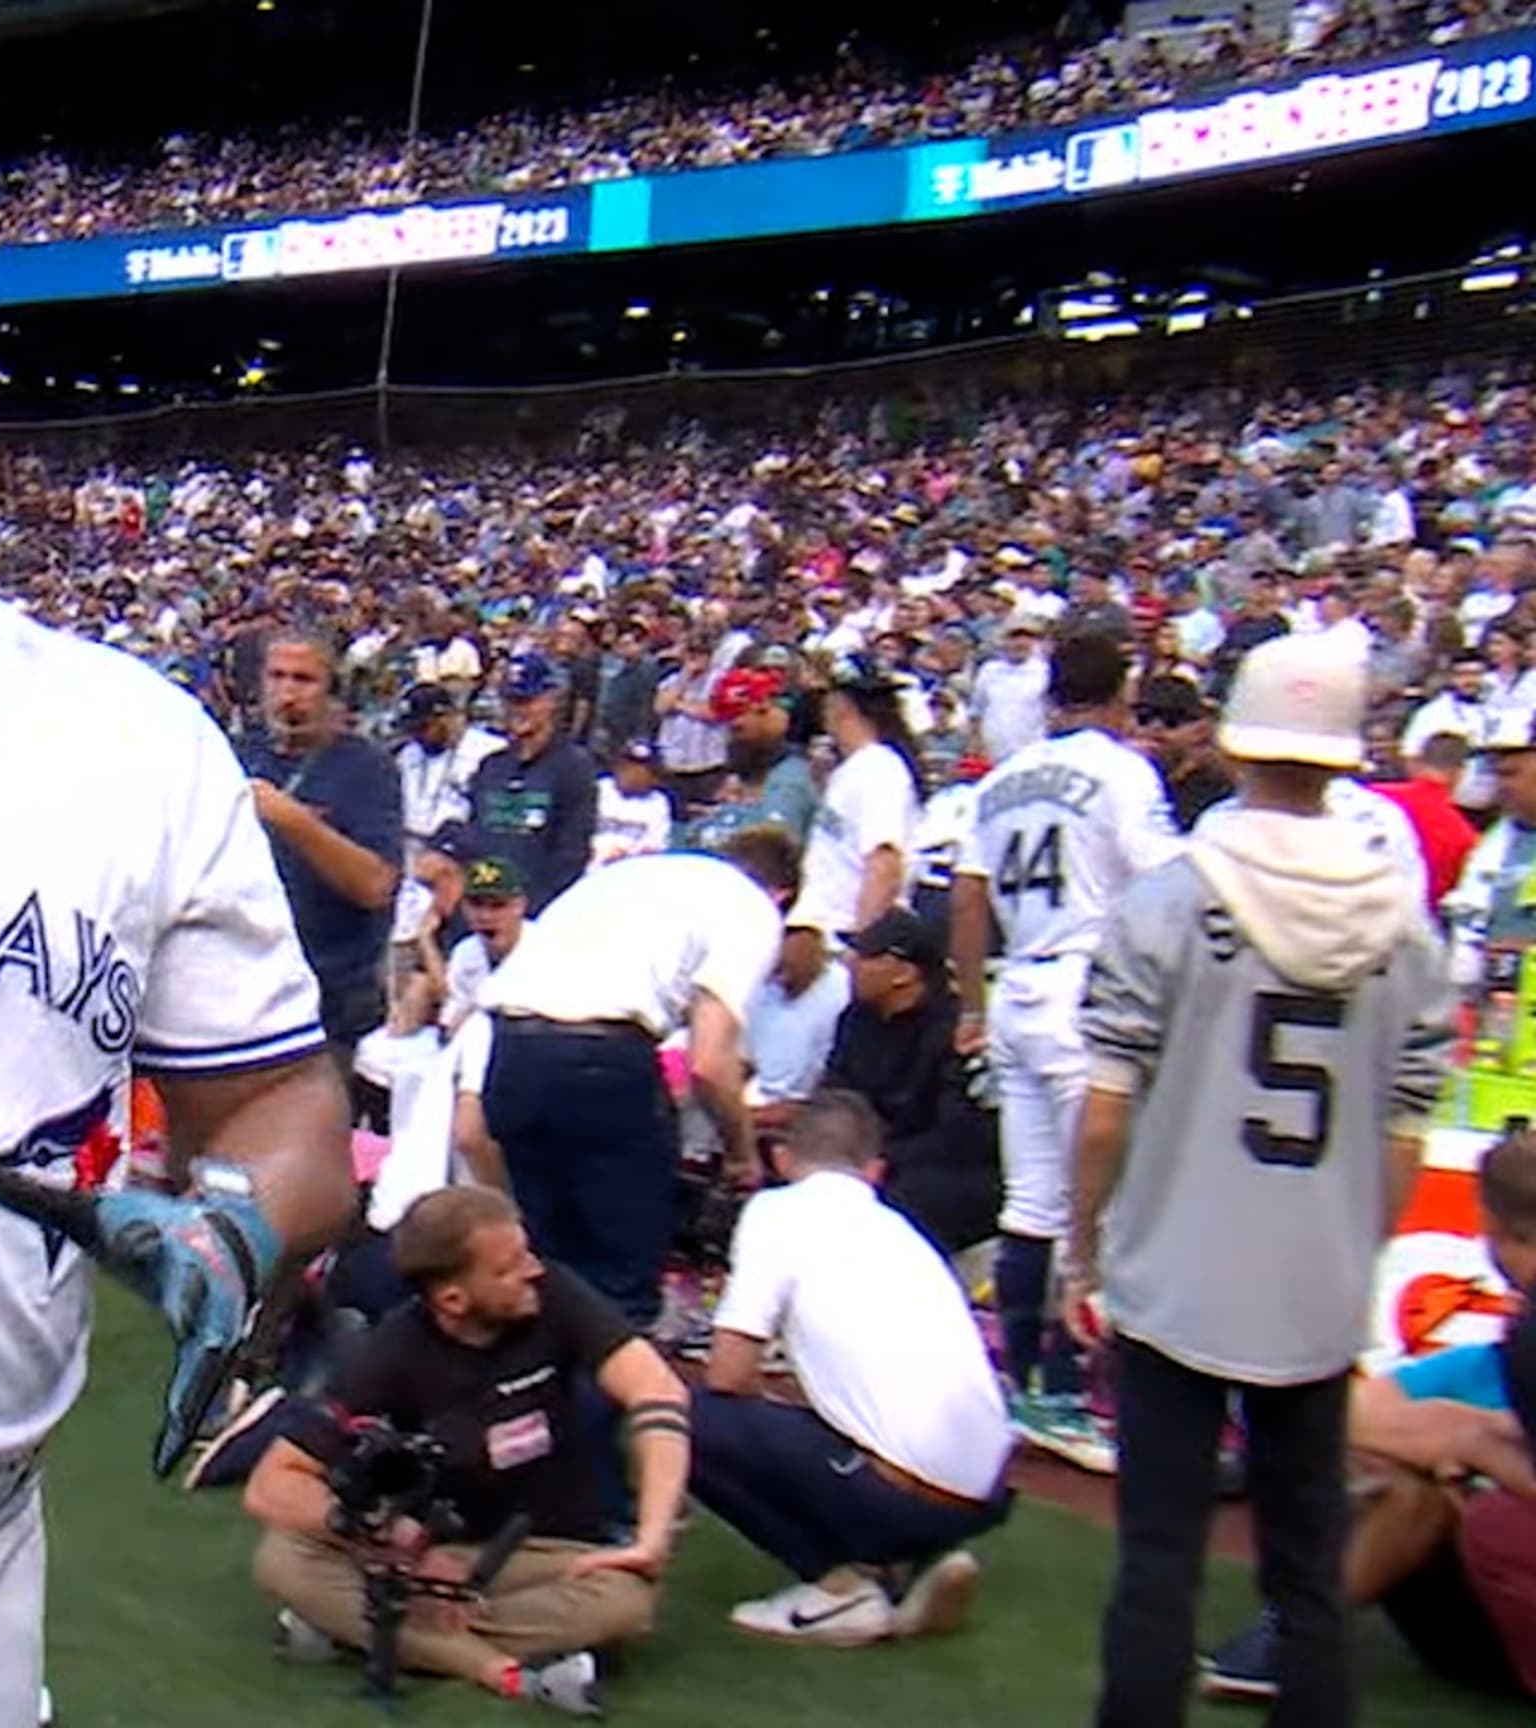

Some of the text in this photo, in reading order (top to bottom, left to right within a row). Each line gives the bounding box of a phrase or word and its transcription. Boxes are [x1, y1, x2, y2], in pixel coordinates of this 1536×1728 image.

[1432, 56, 1532, 118] 2023
[501, 208, 568, 246] 2023
[999, 824, 1066, 911] 44
[1240, 988, 1348, 1169] 5
